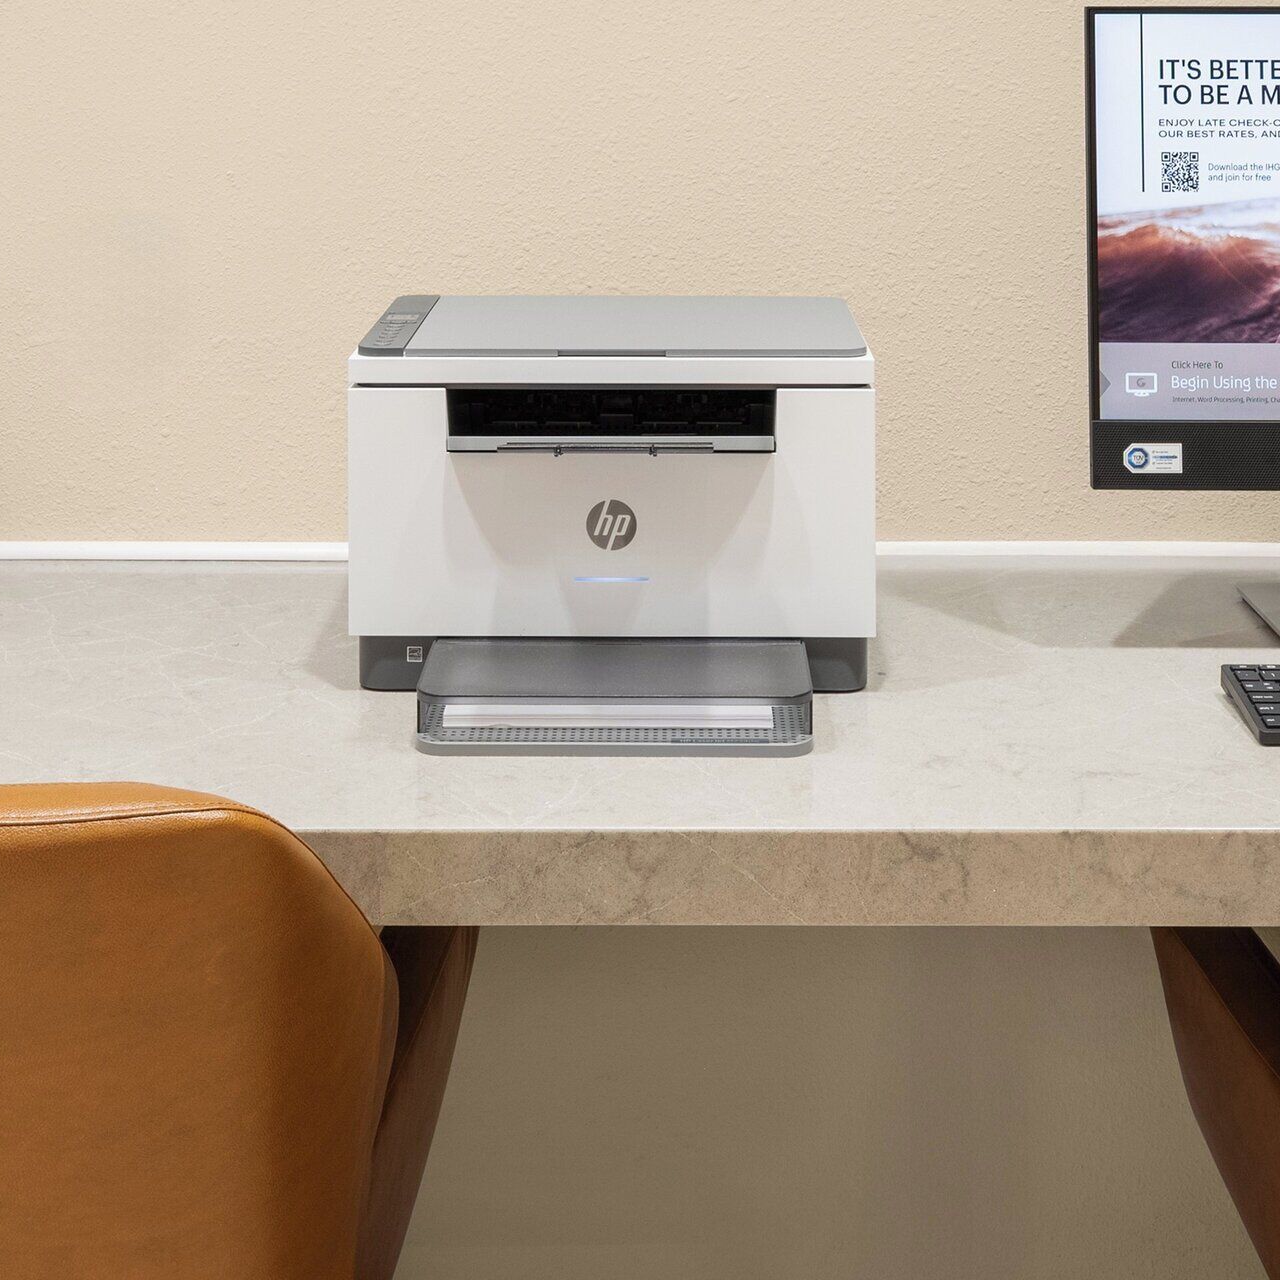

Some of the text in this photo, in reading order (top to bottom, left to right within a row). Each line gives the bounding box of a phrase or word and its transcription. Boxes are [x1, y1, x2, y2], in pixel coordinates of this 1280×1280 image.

[1160, 59, 1201, 79] IT'S
[1159, 85, 1191, 104] TO
[1201, 85, 1229, 104] BE
[1237, 85, 1253, 104] A
[1158, 118, 1195, 127] ENJOY
[1198, 118, 1226, 127] LATE
[1158, 129, 1184, 138] OUR
[1186, 129, 1215, 139] BEST
[1218, 129, 1258, 139] RATES,
[1207, 162, 1249, 172] Download
[1249, 162, 1264, 172] the
[1265, 162, 1280, 172] IHG
[1207, 172, 1272, 183] and join for free
[1171, 360, 1224, 370] Click Here To
[1172, 376, 1208, 391] Begin
[1214, 376, 1251, 392] Using
[1255, 376, 1277, 389] the
[591, 499, 633, 550] hp
